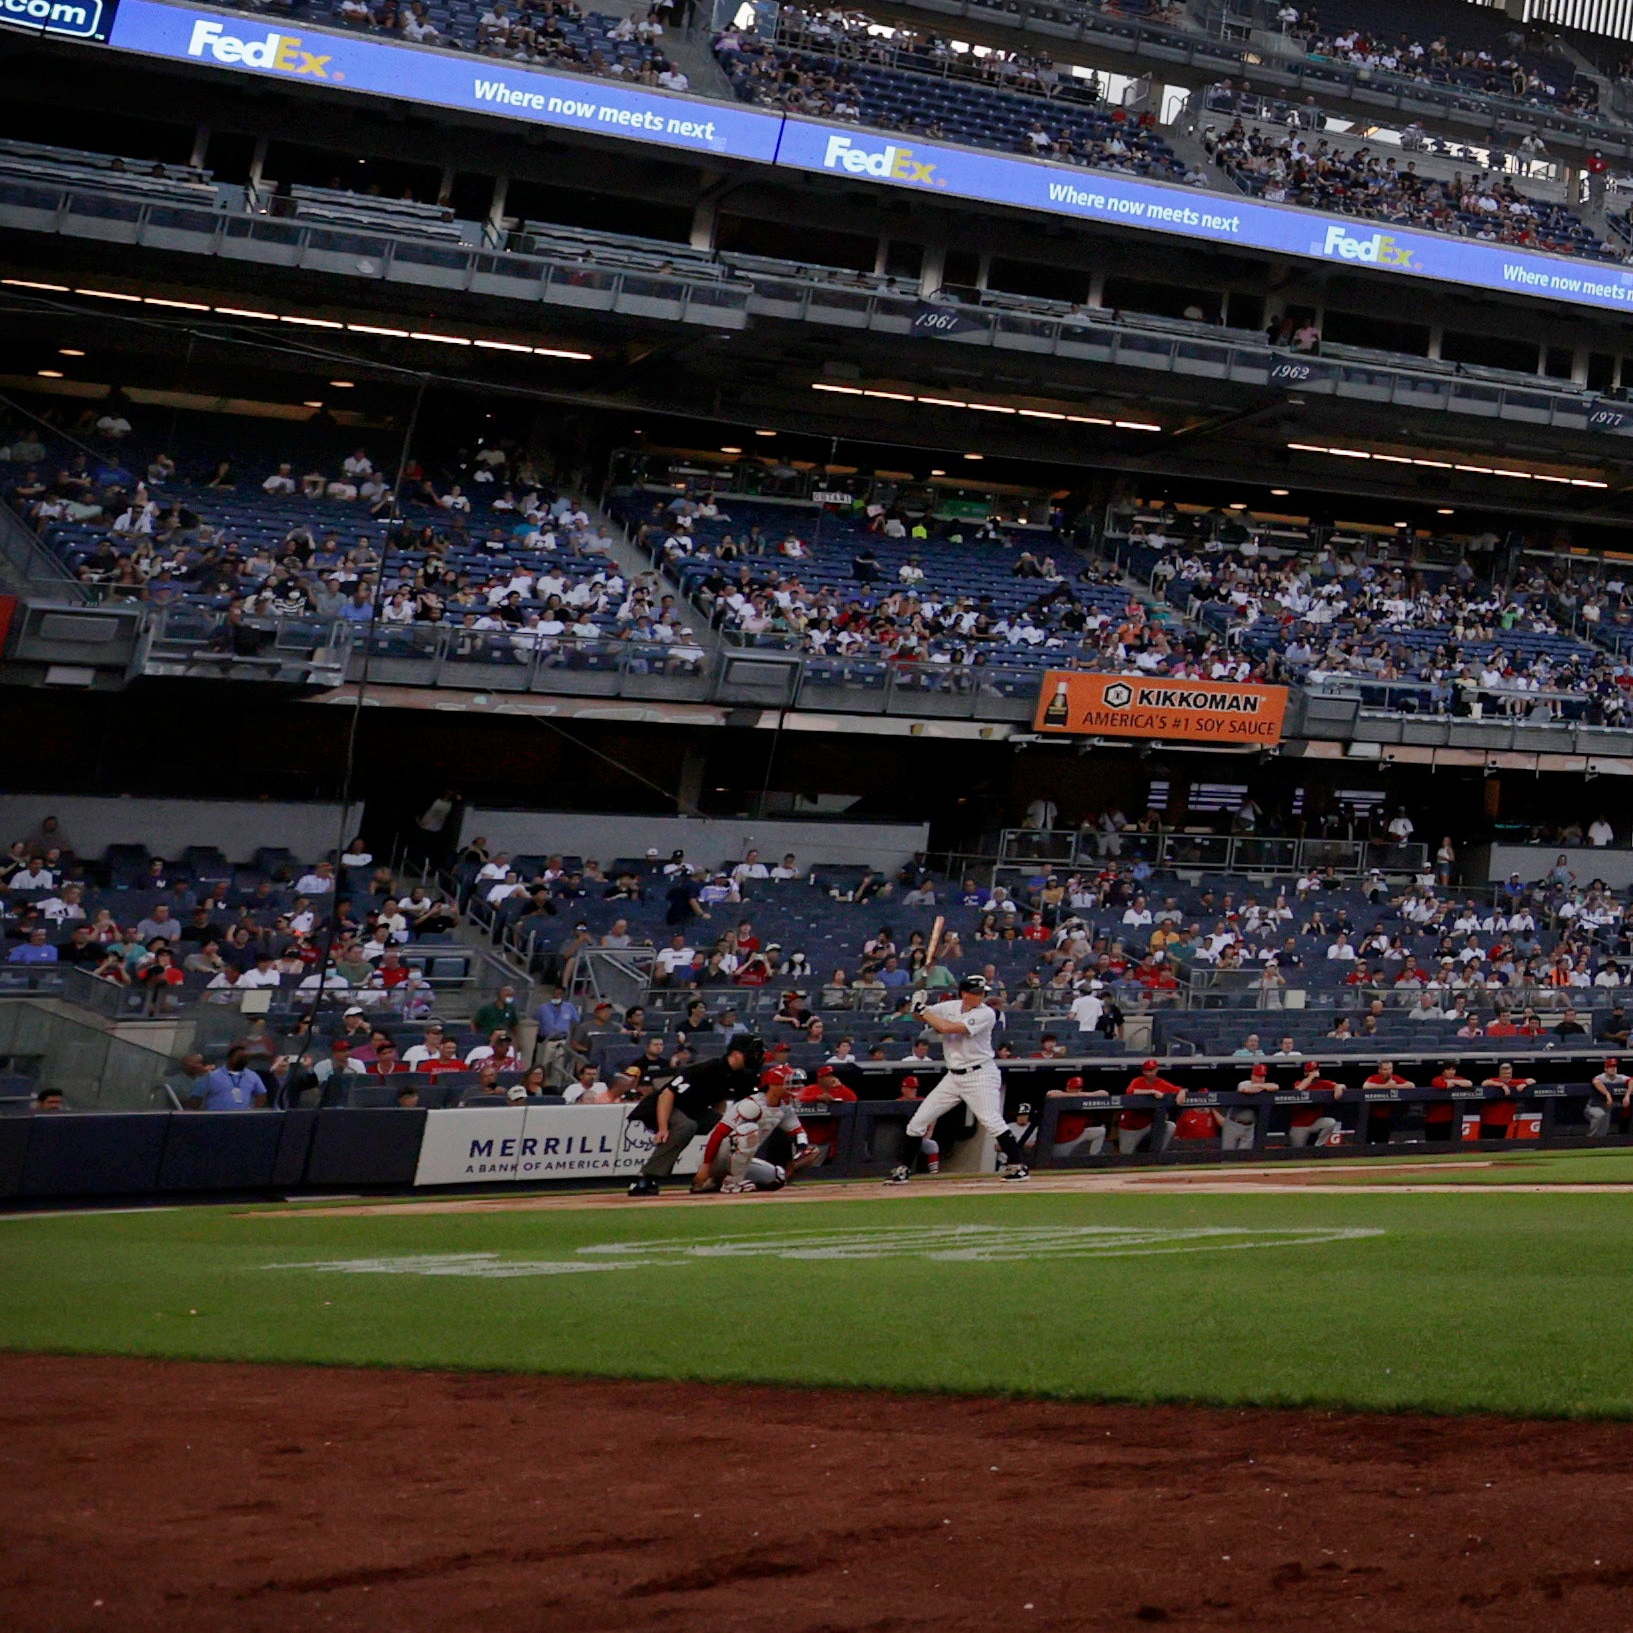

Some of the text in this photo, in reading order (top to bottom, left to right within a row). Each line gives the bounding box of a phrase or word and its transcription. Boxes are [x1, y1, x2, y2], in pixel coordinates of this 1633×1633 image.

[188, 20, 332, 78] FedEx
[475, 80, 715, 141] Where now meets next
[824, 136, 933, 186] FedEx
[1050, 183, 1239, 232] Where now meets next
[1324, 227, 1412, 268] FedEx
[1504, 264, 1548, 286] Where
[1551, 277, 1581, 291] now
[1583, 282, 1625, 299] meets
[915, 313, 958, 329] 1961
[1271, 365, 1310, 380] 1962
[1590, 411, 1624, 426] 1977
[1138, 687, 1260, 713] KIKKOMAN
[1082, 710, 1275, 736] AMERICA'S #1 SOY SAUCE
[469, 1135, 613, 1158] MERRILL
[465, 1164, 474, 1173] A
[478, 1163, 518, 1173] BANK
[523, 1162, 541, 1171] OF
[543, 1160, 609, 1170] AMERICA
